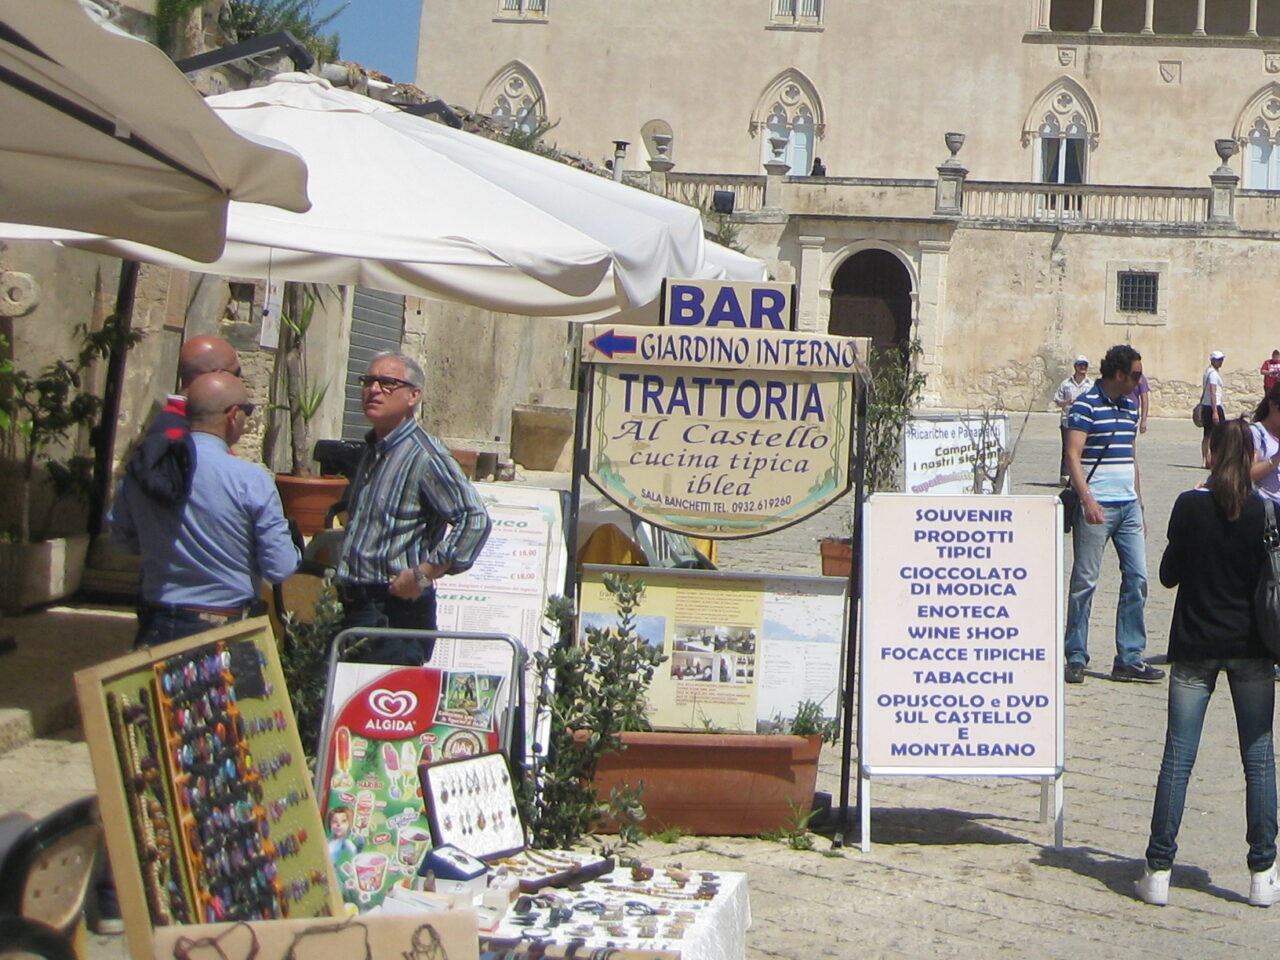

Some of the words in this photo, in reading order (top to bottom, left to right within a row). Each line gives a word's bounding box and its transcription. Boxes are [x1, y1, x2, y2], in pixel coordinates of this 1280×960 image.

[670, 285, 786, 330] BAR
[641, 333, 748, 364] GIARDINO
[757, 338, 856, 368] INTERNO
[619, 373, 825, 422] TRATTORIA
[612, 419, 667, 441] Al
[682, 424, 829, 450] Castello
[912, 427, 949, 440] Ricariche
[951, 430, 956, 439] e
[629, 449, 721, 469] cucina
[729, 453, 810, 479] tipica
[686, 474, 752, 497] iblea
[641, 488, 663, 504] SALA
[664, 495, 711, 512] BANCHETTI
[915, 509, 1013, 522] SOUVENIR
[914, 530, 1014, 543] PRODOTTI
[936, 546, 992, 559] TIPICI
[899, 567, 1027, 580] CIOCCOLATO
[911, 583, 931, 596] DI
[936, 583, 1016, 596] MODICA
[917, 606, 1010, 618] ENOTECA
[908, 626, 960, 640] WINE
[966, 626, 1019, 640] SHOP
[881, 647, 968, 661] FOCACCE
[974, 648, 1046, 661] TIPICHE
[913, 671, 1014, 684] TABACCHI
[877, 694, 985, 707] OPUSCOLO
[991, 697, 1001, 707] e
[1007, 695, 1049, 707] DVD
[895, 711, 929, 724] SUL
[934, 711, 1032, 724] CASTELLO
[365, 718, 414, 732] ALGIDA
[958, 727, 968, 740] E
[891, 743, 1036, 757] MONTALBANO
